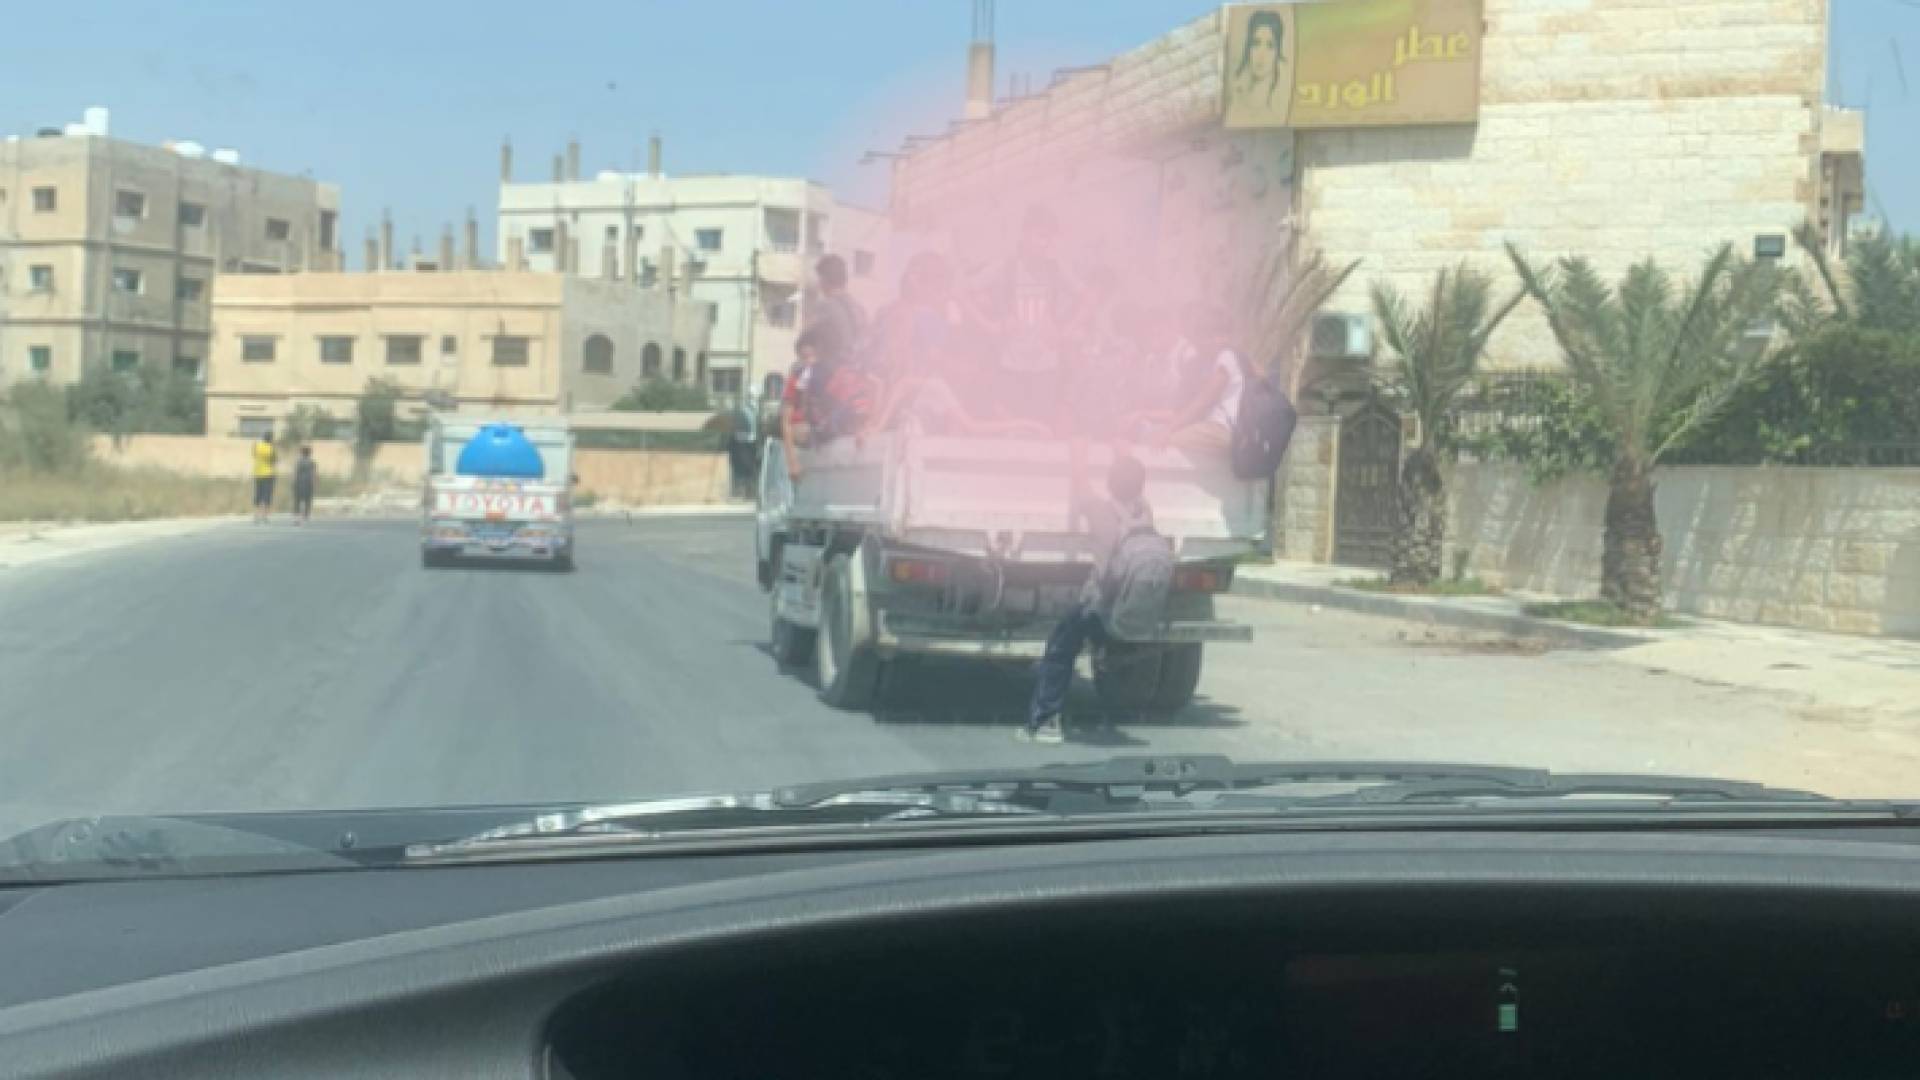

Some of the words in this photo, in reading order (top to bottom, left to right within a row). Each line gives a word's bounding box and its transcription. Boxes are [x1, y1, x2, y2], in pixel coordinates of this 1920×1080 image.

[1394, 25, 1470, 65] عطر
[1299, 71, 1394, 108] الورد
[446, 493, 544, 512] TOYOTA
